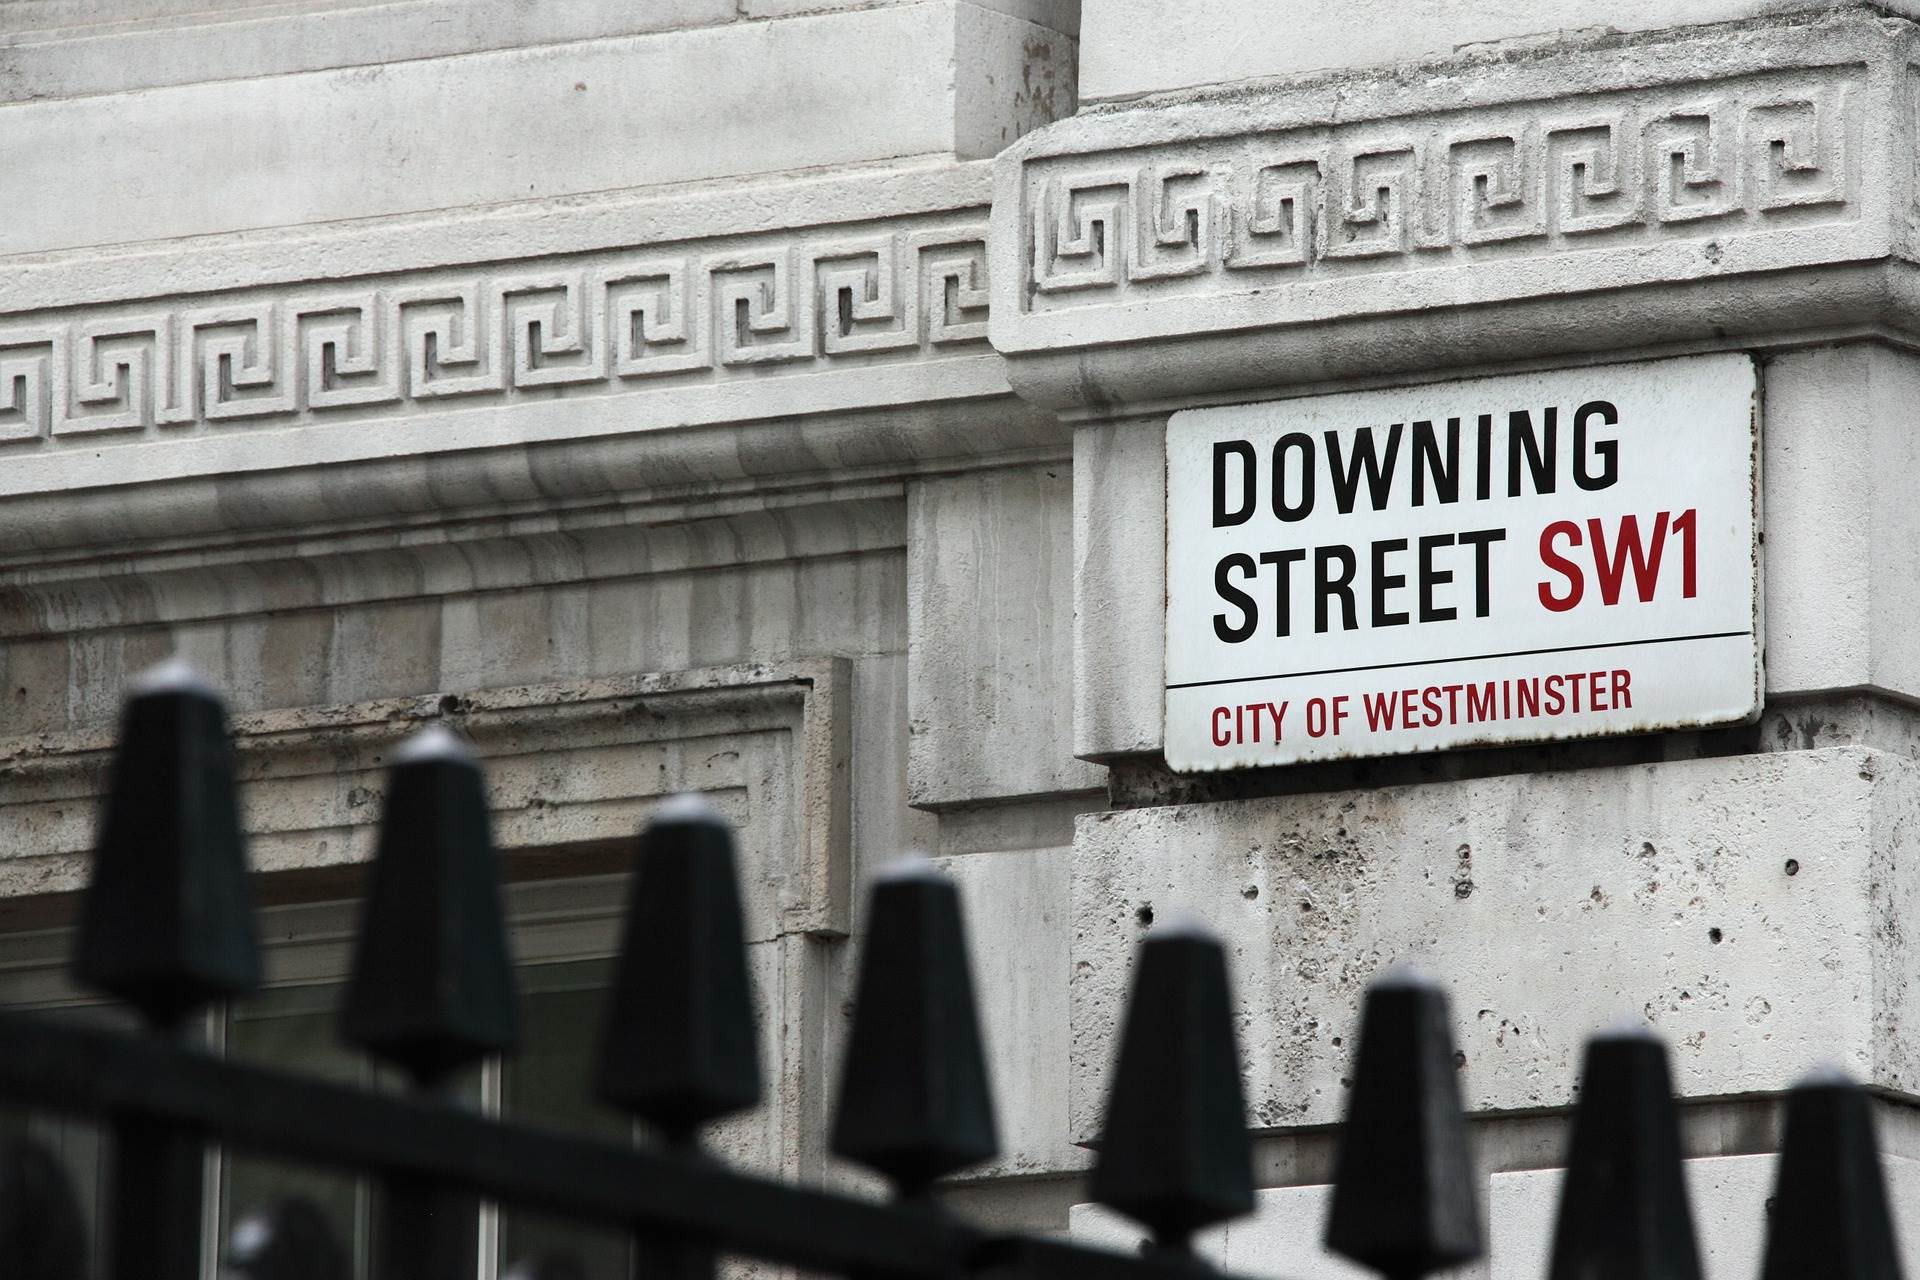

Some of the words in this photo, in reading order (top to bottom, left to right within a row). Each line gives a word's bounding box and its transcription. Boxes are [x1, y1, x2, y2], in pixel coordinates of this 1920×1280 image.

[1212, 400, 1619, 528] DOWNING
[1212, 527, 1507, 643] STREET
[1537, 508, 1697, 612] SW1
[1212, 700, 1289, 747] CITY
[1306, 695, 1349, 739] OF
[1363, 669, 1633, 733] WESTMINSTER
